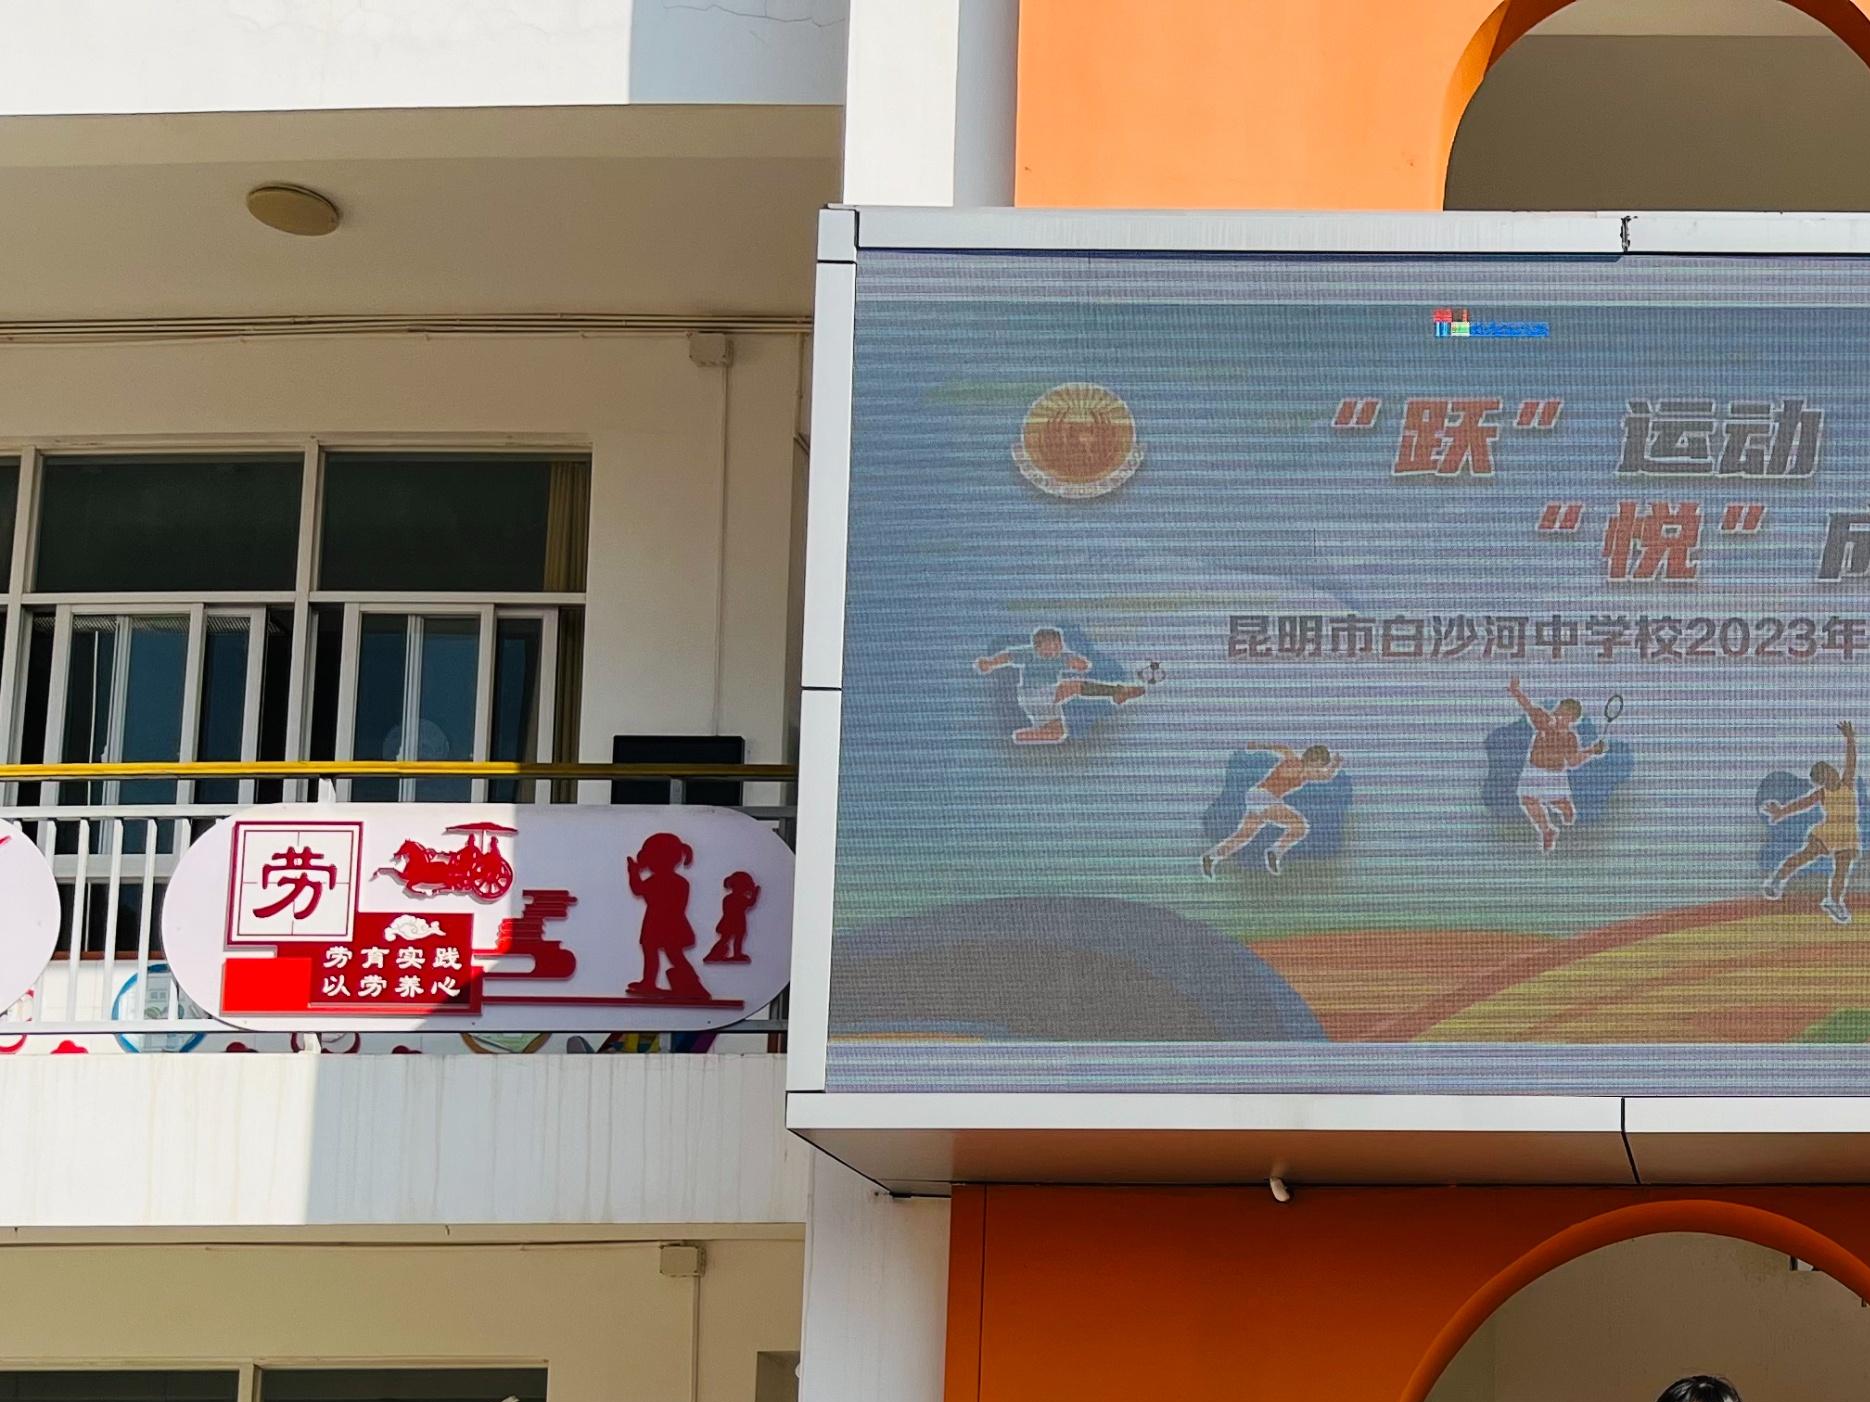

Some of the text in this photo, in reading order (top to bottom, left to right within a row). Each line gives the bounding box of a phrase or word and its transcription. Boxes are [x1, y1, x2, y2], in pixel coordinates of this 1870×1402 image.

[1615, 398, 1825, 479] 运动
[252, 846, 338, 920] 劳
[323, 946, 463, 970] 劳育实践
[322, 974, 461, 998] 以劳养心
